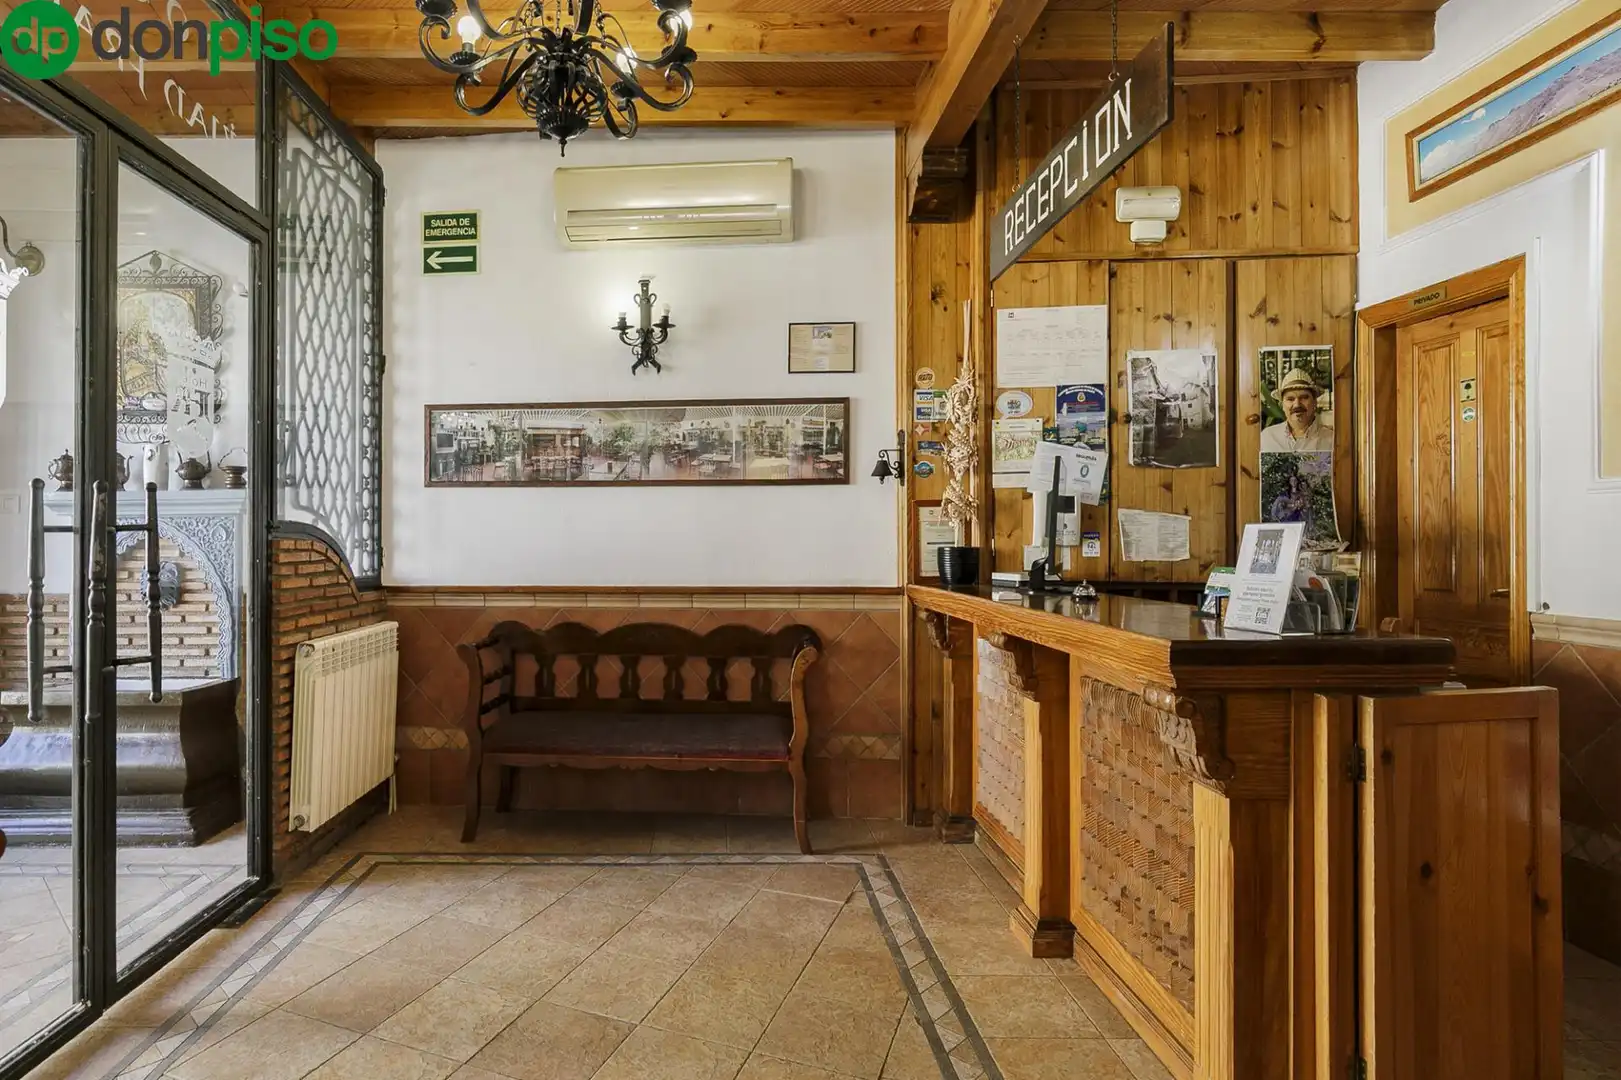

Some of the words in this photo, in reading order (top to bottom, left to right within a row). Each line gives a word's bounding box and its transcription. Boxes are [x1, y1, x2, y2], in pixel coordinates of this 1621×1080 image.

[430, 218, 458, 227] SALIDA
[459, 217, 470, 226] DE
[425, 227, 476, 237] EMERGENCIA
[1413, 292, 1440, 306] PRIVADO
